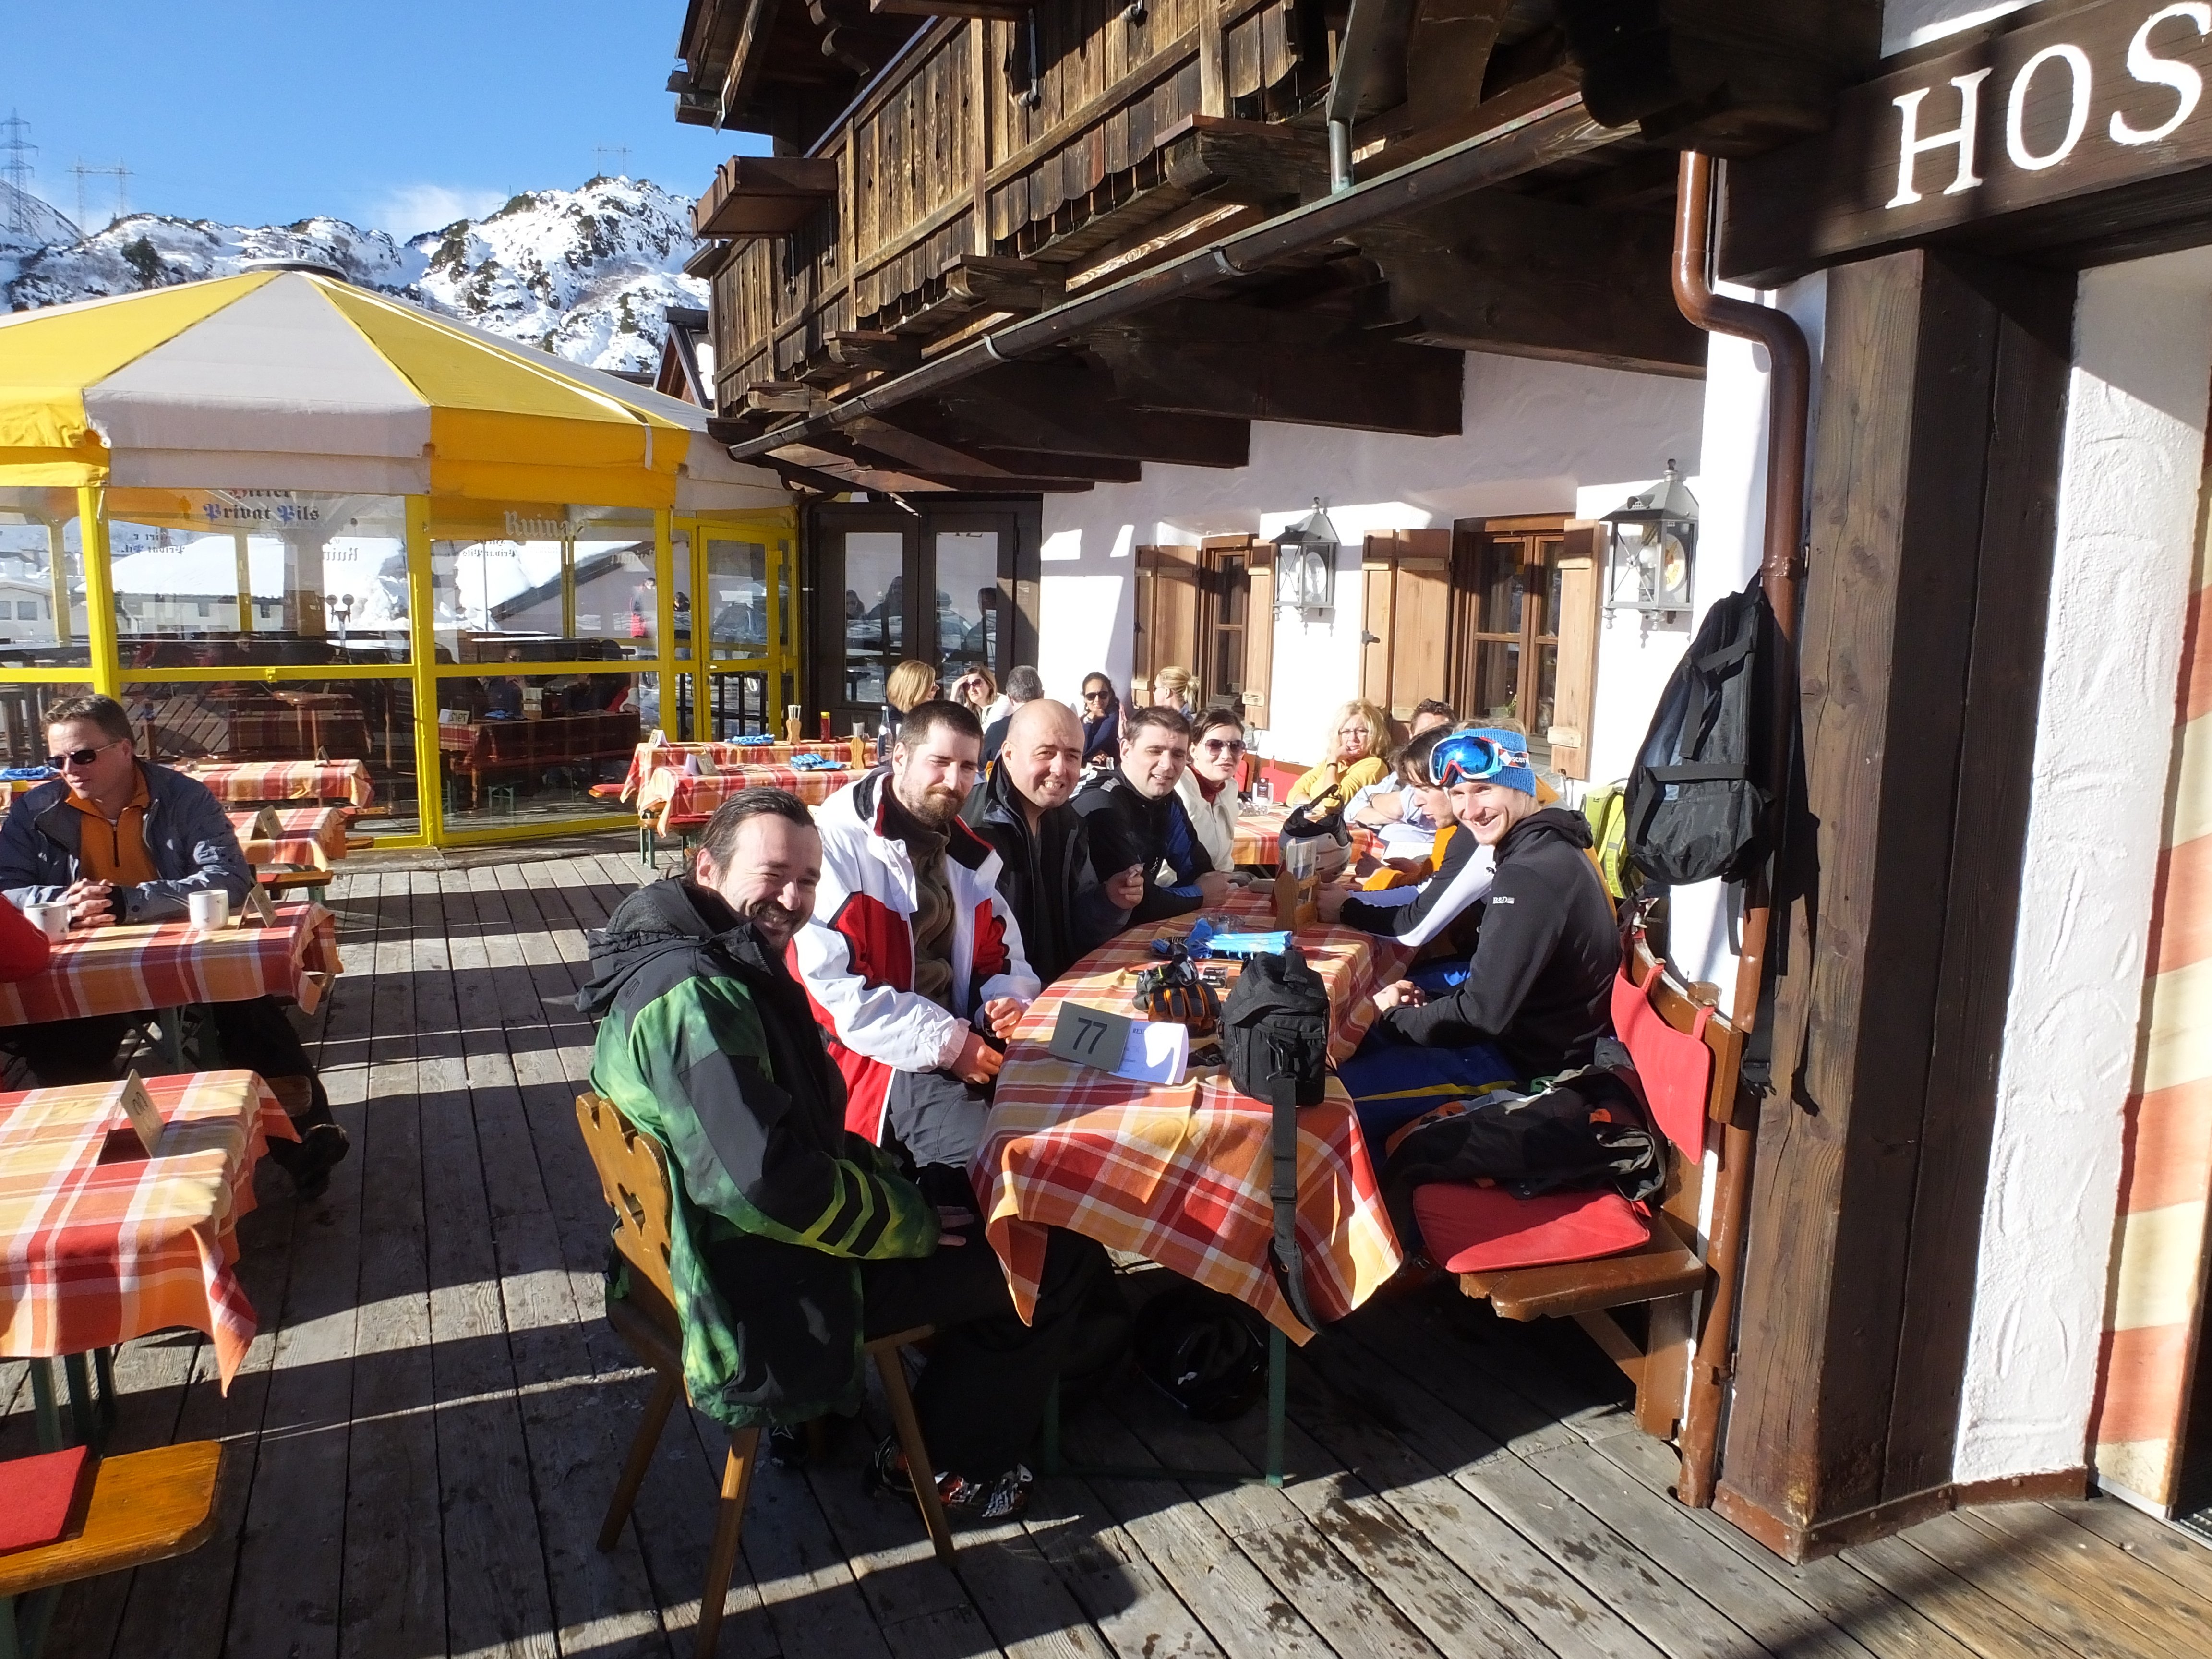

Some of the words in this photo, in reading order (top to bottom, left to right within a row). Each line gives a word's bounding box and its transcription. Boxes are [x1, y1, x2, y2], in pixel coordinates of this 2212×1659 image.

[1885, 1, 2212, 209] HOS
[203, 504, 271, 523] Privat
[277, 504, 320, 526] Pils
[1073, 1017, 1107, 1055] 77
